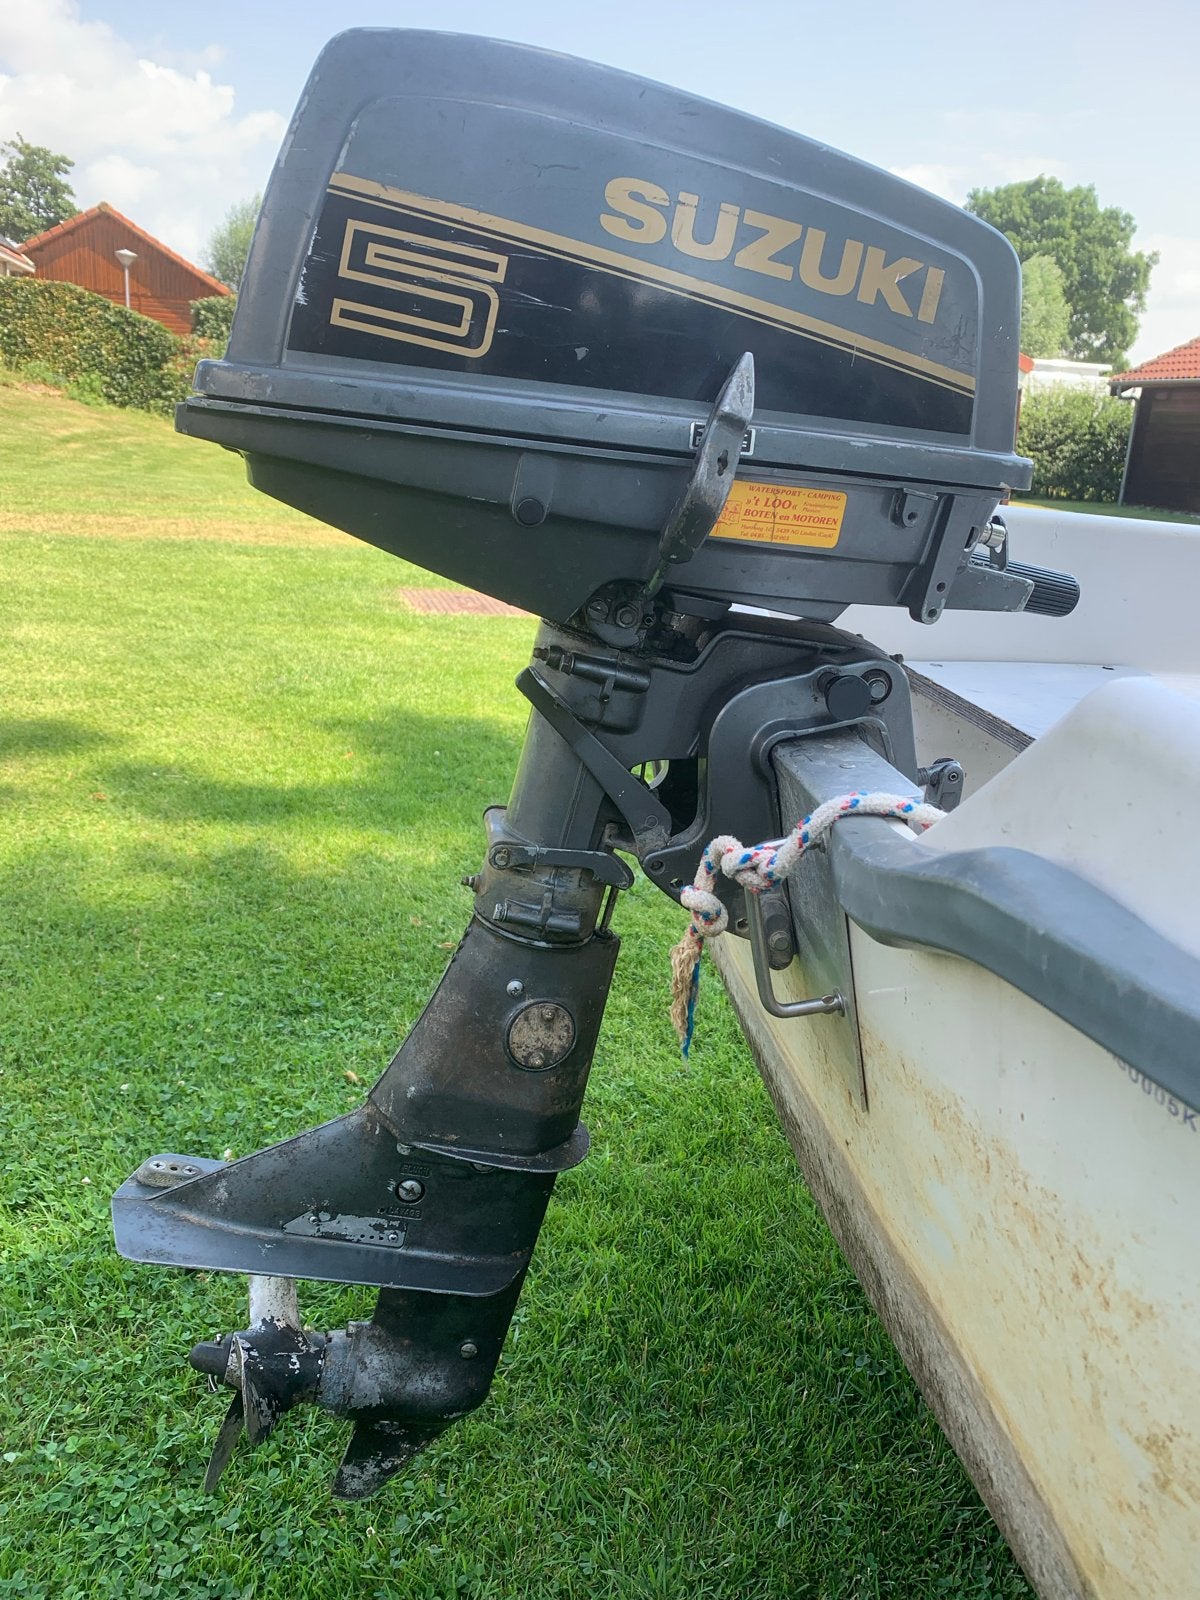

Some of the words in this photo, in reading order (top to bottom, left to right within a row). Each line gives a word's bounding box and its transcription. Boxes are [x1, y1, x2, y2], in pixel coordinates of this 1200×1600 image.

[600, 177, 945, 324] SUZUKI
[748, 484, 801, 496] WATERSPORT
[807, 491, 841, 501] CAMPING
[743, 508, 777, 519] BOTEN
[791, 513, 838, 526] MOTOREN
